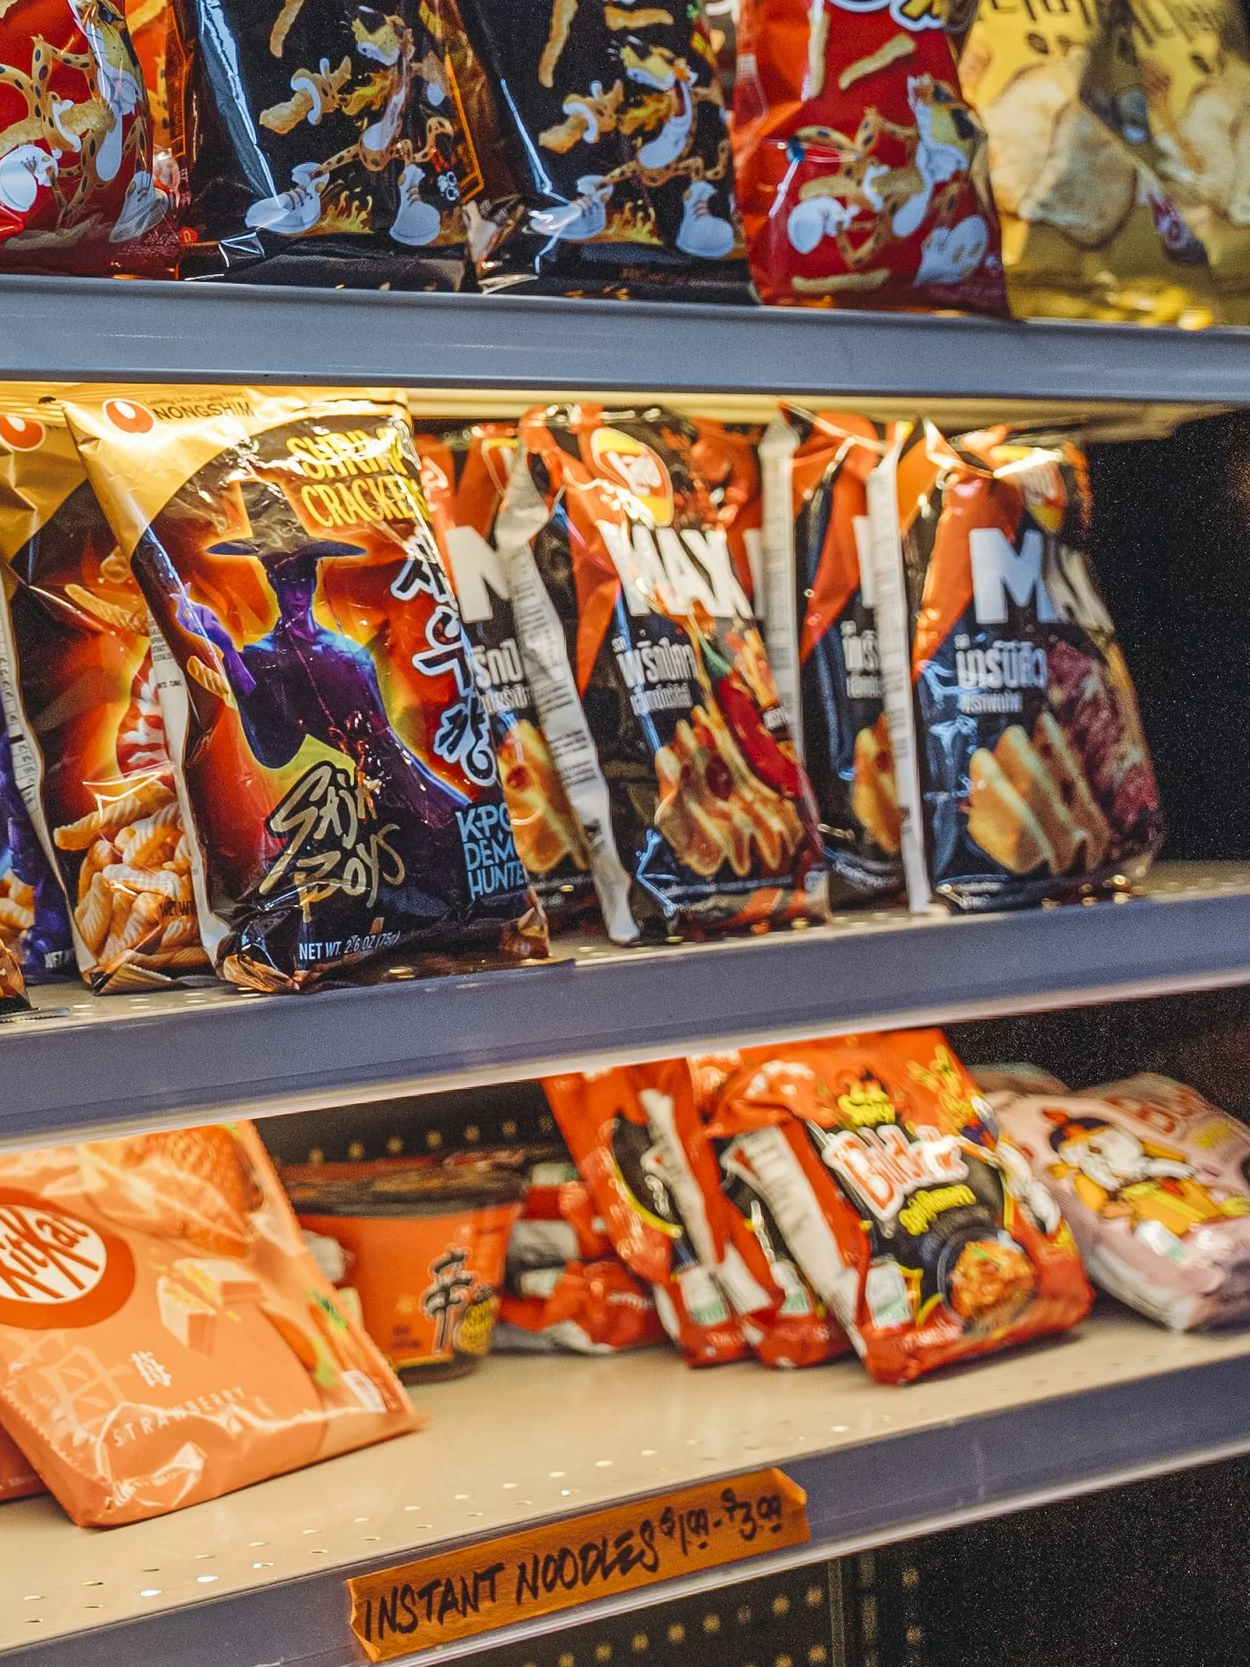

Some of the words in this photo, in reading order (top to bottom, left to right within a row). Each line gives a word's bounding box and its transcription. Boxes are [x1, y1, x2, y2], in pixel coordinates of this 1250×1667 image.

[152, 400, 256, 422] NONGSHIM
[596, 519, 754, 620] MAX
[391, 526, 498, 787] 새우깡
[297, 823, 405, 925] BOYS
[299, 942, 321, 961] NET
[324, 940, 343, 958] WT.
[361, 935, 375, 951] OZ
[423, 1245, 477, 1357] 辛
[111, 1384, 247, 1448] STRAWBERRY
[364, 1558, 506, 1643] INSTANT
[515, 1524, 662, 1606] NOODLES
